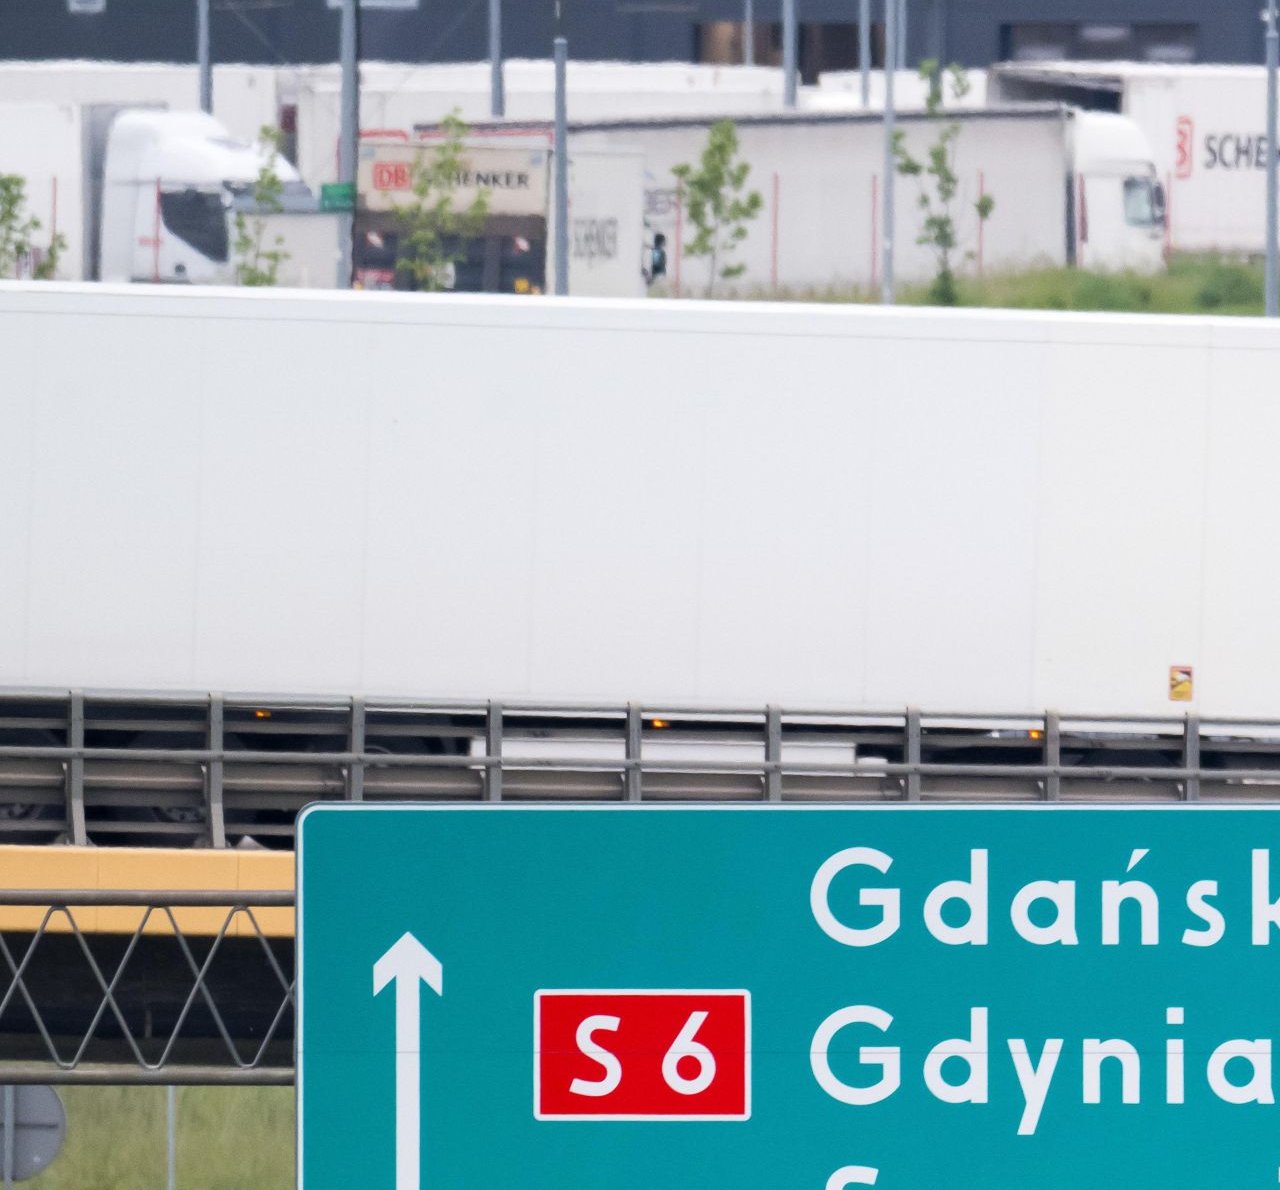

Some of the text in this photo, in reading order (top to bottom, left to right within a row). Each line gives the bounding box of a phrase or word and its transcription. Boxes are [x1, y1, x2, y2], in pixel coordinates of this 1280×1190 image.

[376, 165, 410, 189] DB
[568, 1010, 717, 1098] S 6
[810, 1005, 1275, 1136] Gdynia
